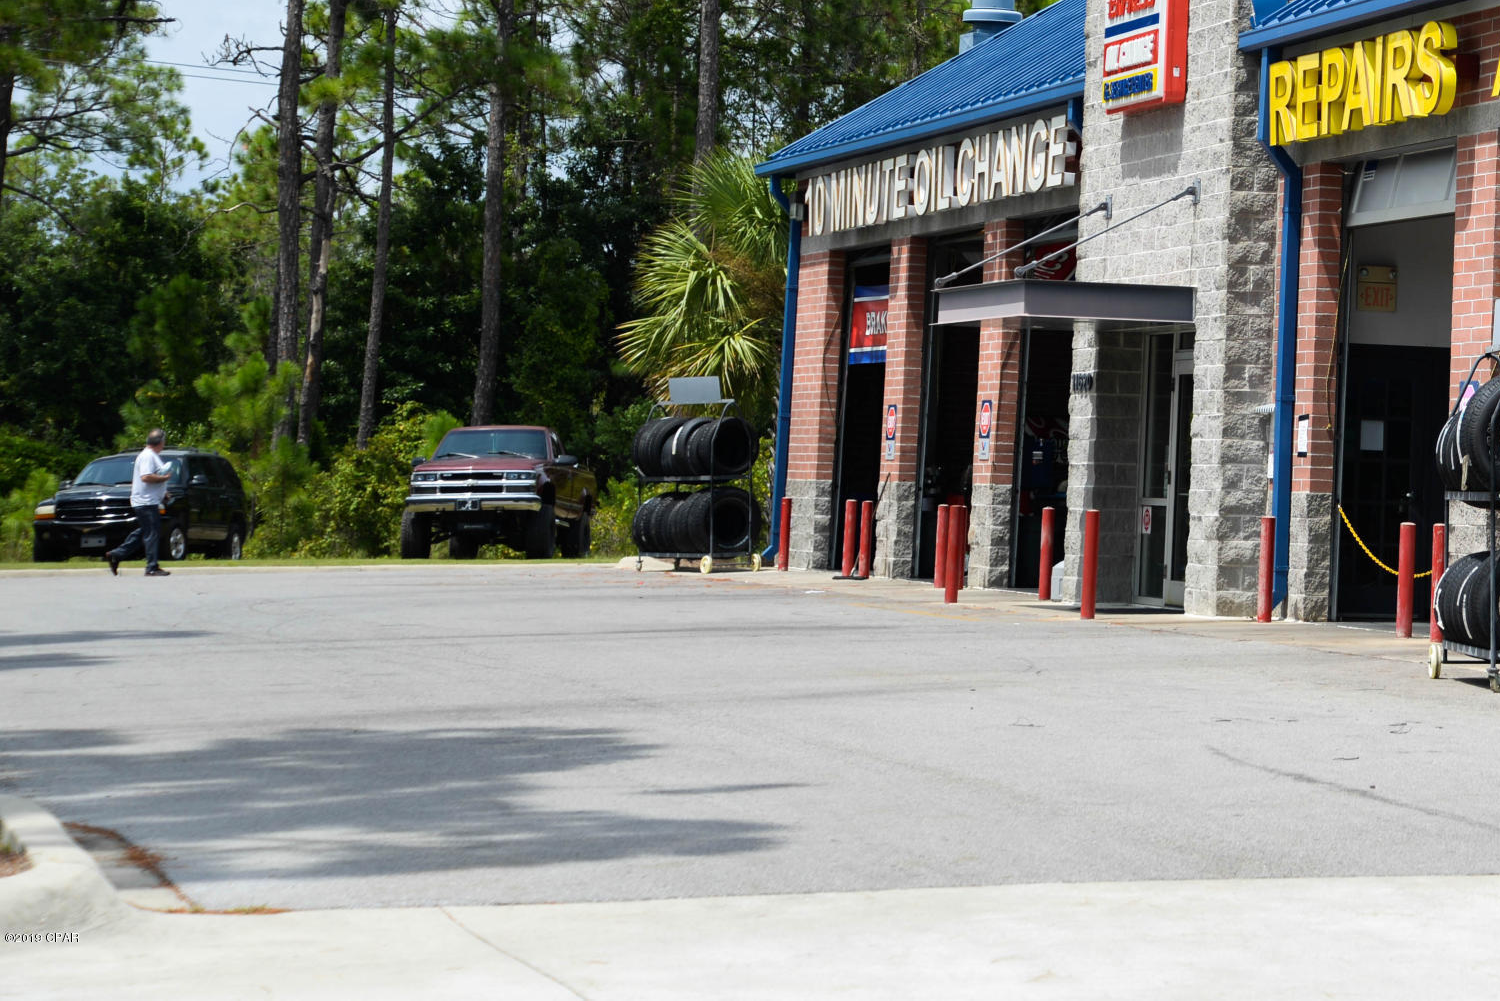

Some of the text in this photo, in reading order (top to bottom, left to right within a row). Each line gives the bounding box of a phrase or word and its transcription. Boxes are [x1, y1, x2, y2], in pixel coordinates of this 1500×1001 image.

[1269, 20, 1457, 145] REPAIRS
[805, 114, 1073, 237] 10 MINUTE OIL CHANGE
[1364, 286, 1391, 307] EXIT
